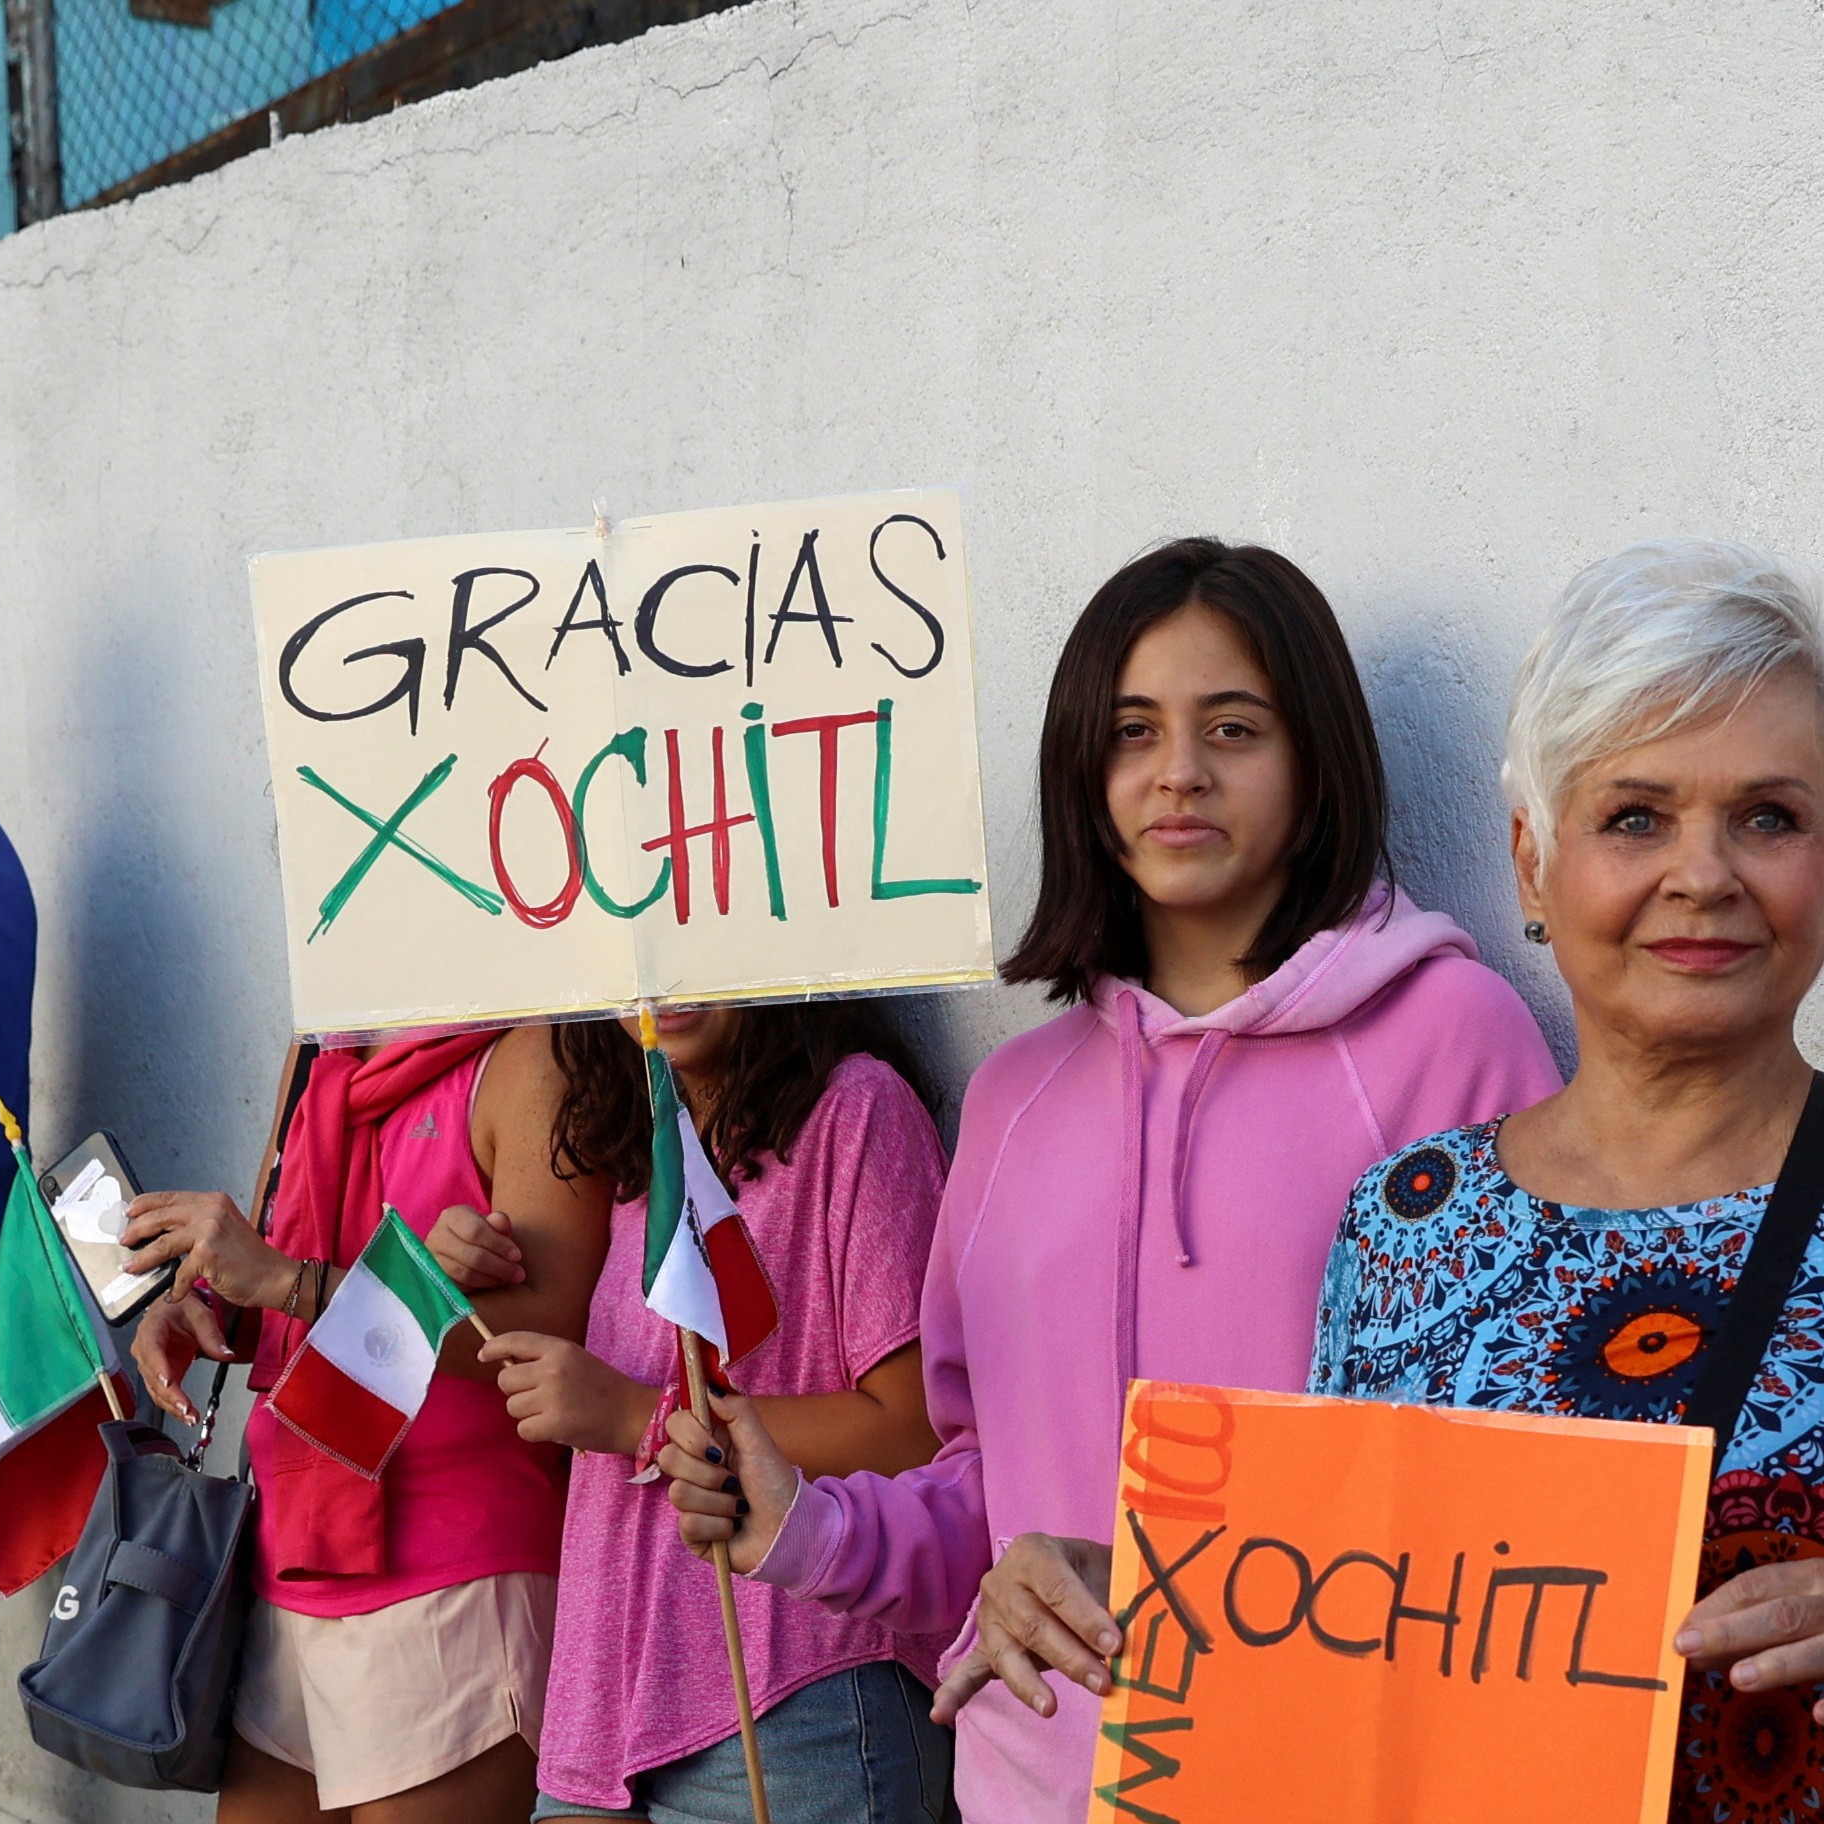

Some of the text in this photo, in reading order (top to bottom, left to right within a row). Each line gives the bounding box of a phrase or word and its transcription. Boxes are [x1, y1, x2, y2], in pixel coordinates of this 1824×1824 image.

[278, 514, 947, 735] GRACIAS
[50, 1584, 80, 1620] G
[1117, 1508, 1669, 1692] XOCHITL
